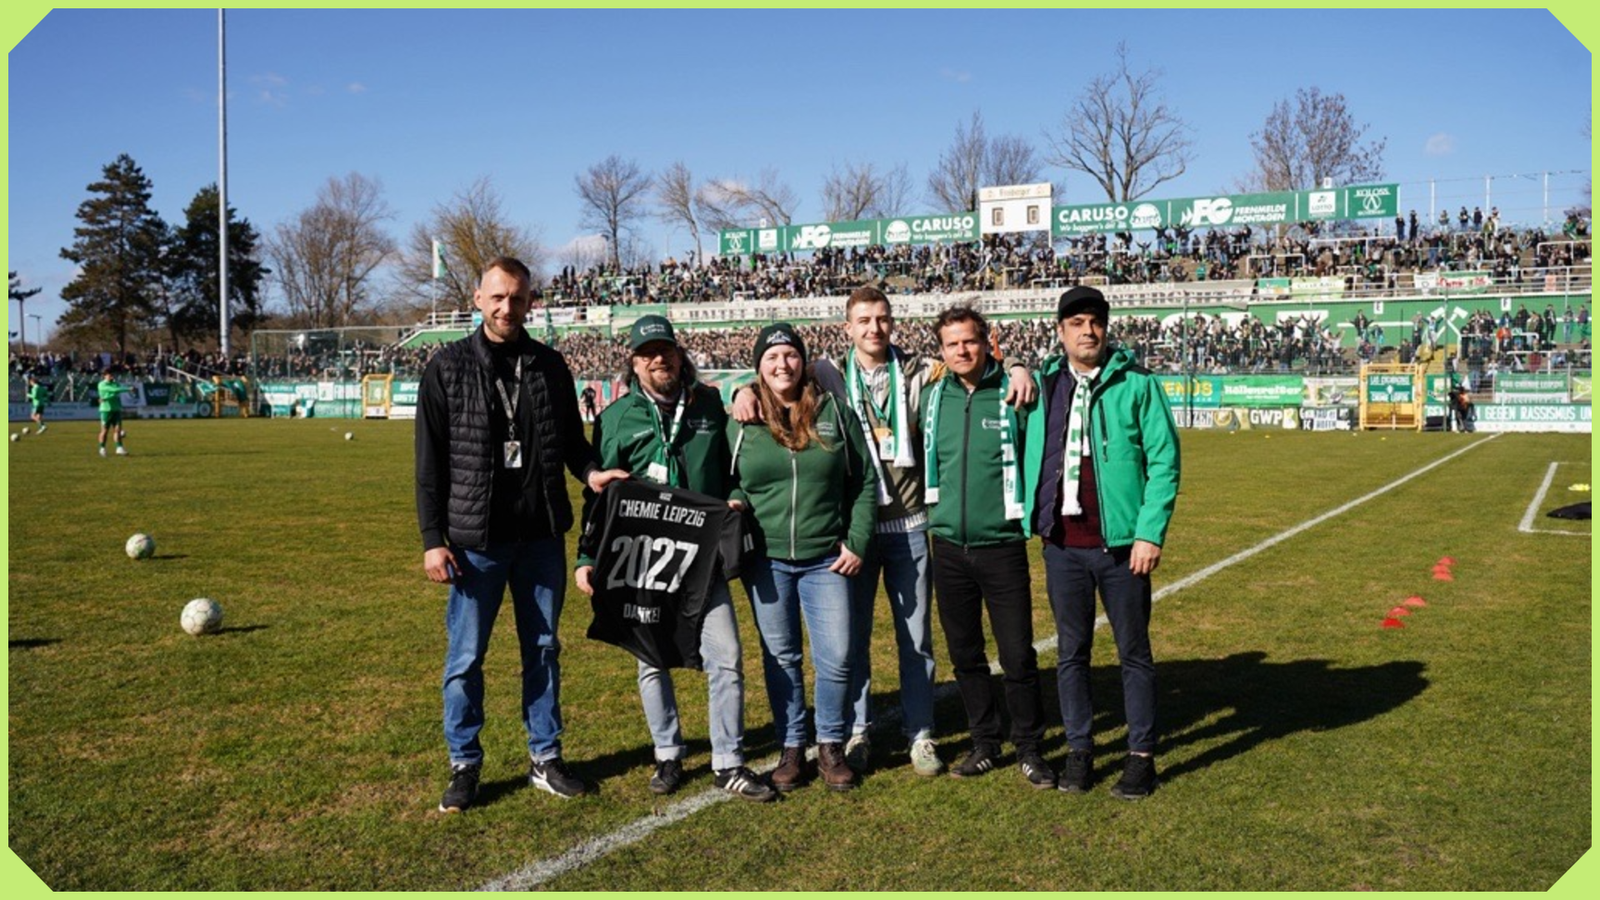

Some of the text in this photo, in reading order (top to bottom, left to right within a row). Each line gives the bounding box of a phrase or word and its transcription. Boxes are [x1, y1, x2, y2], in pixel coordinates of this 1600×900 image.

[1059, 206, 1128, 223] CARUSO
[1235, 203, 1287, 215] FERNMELDE
[912, 216, 974, 232] CARUSO
[1232, 213, 1286, 223] MONTAGEN
[1163, 380, 1213, 397] ENUS
[1250, 409, 1283, 425] GWP
[1485, 406, 1515, 420] GEGEN
[1520, 405, 1576, 420] RASSISMUS
[619, 499, 706, 527] CHEMIE LEIPZIG
[607, 535, 698, 593] 2027
[623, 603, 660, 624] DANKE!
